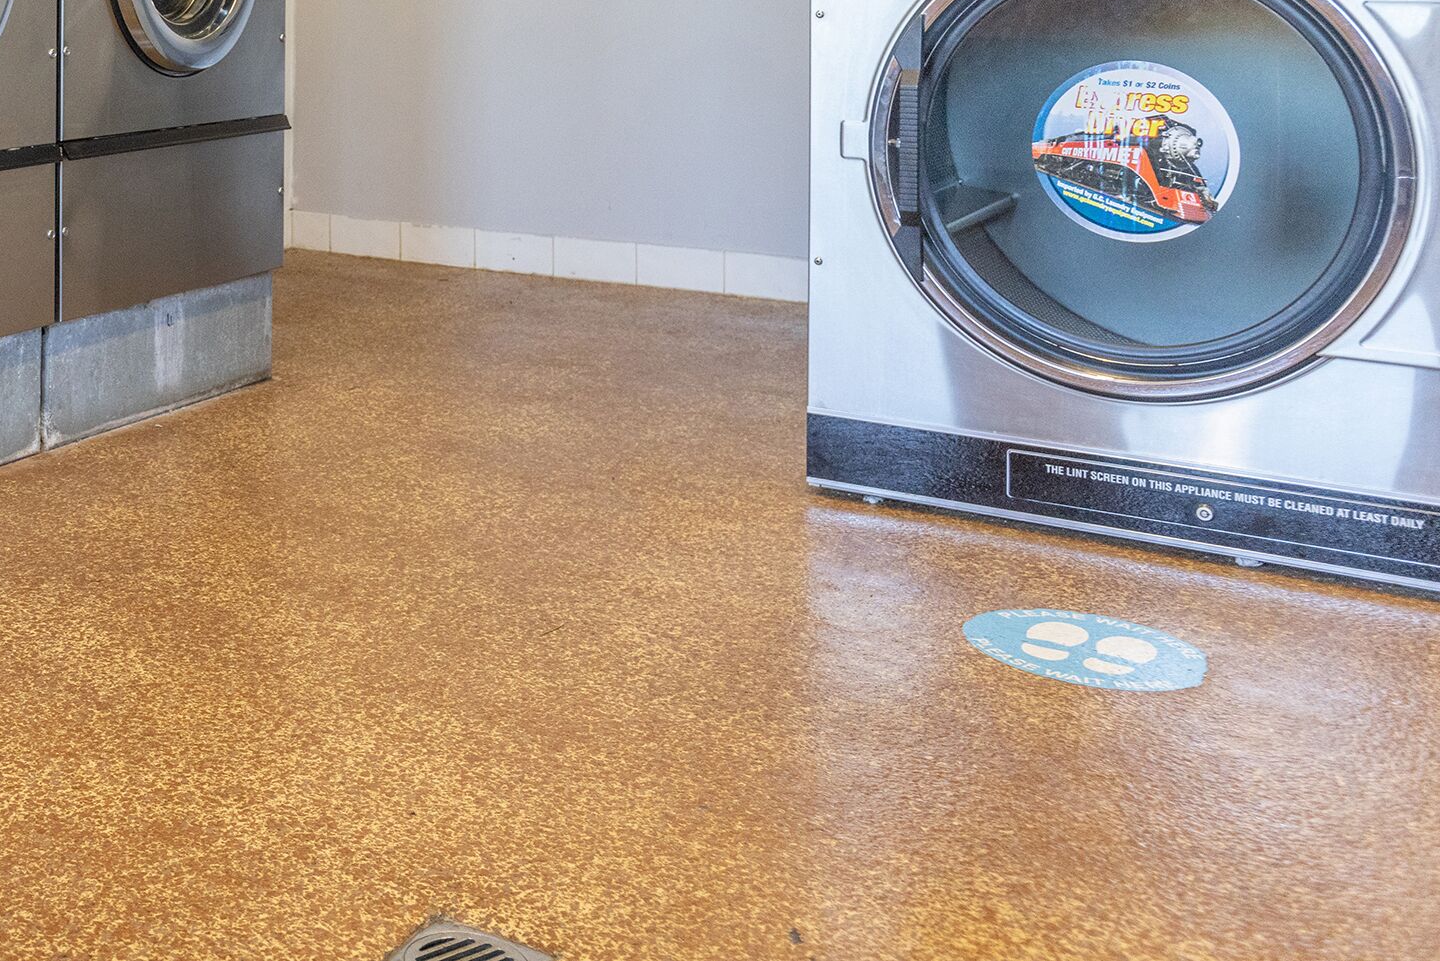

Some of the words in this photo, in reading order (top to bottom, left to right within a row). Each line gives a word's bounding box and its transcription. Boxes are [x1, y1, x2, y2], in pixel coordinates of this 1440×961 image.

[1098, 78, 1120, 87] Takes
[1158, 82, 1181, 90] Coins
[1075, 85, 1190, 115] ress
[1045, 464, 1064, 475] THE
[1066, 468, 1089, 479] LINT
[1090, 470, 1130, 485] SCREEN
[1132, 478, 1147, 488] ON
[1149, 480, 1173, 492] THIS
[1174, 484, 1232, 501] APPLIANCE
[1234, 493, 1266, 506] MUST
[1268, 498, 1282, 508] BE
[1284, 500, 1334, 516] CLEANED
[1336, 508, 1351, 518] AT
[1352, 510, 1388, 524] LEAST
[1390, 516, 1425, 530] DAILY
[998, 610, 1087, 620] PLEASE
[1096, 616, 1155, 635] WAIT
[970, 637, 1041, 671] PLEASE
[1046, 668, 1104, 686] WAIT
